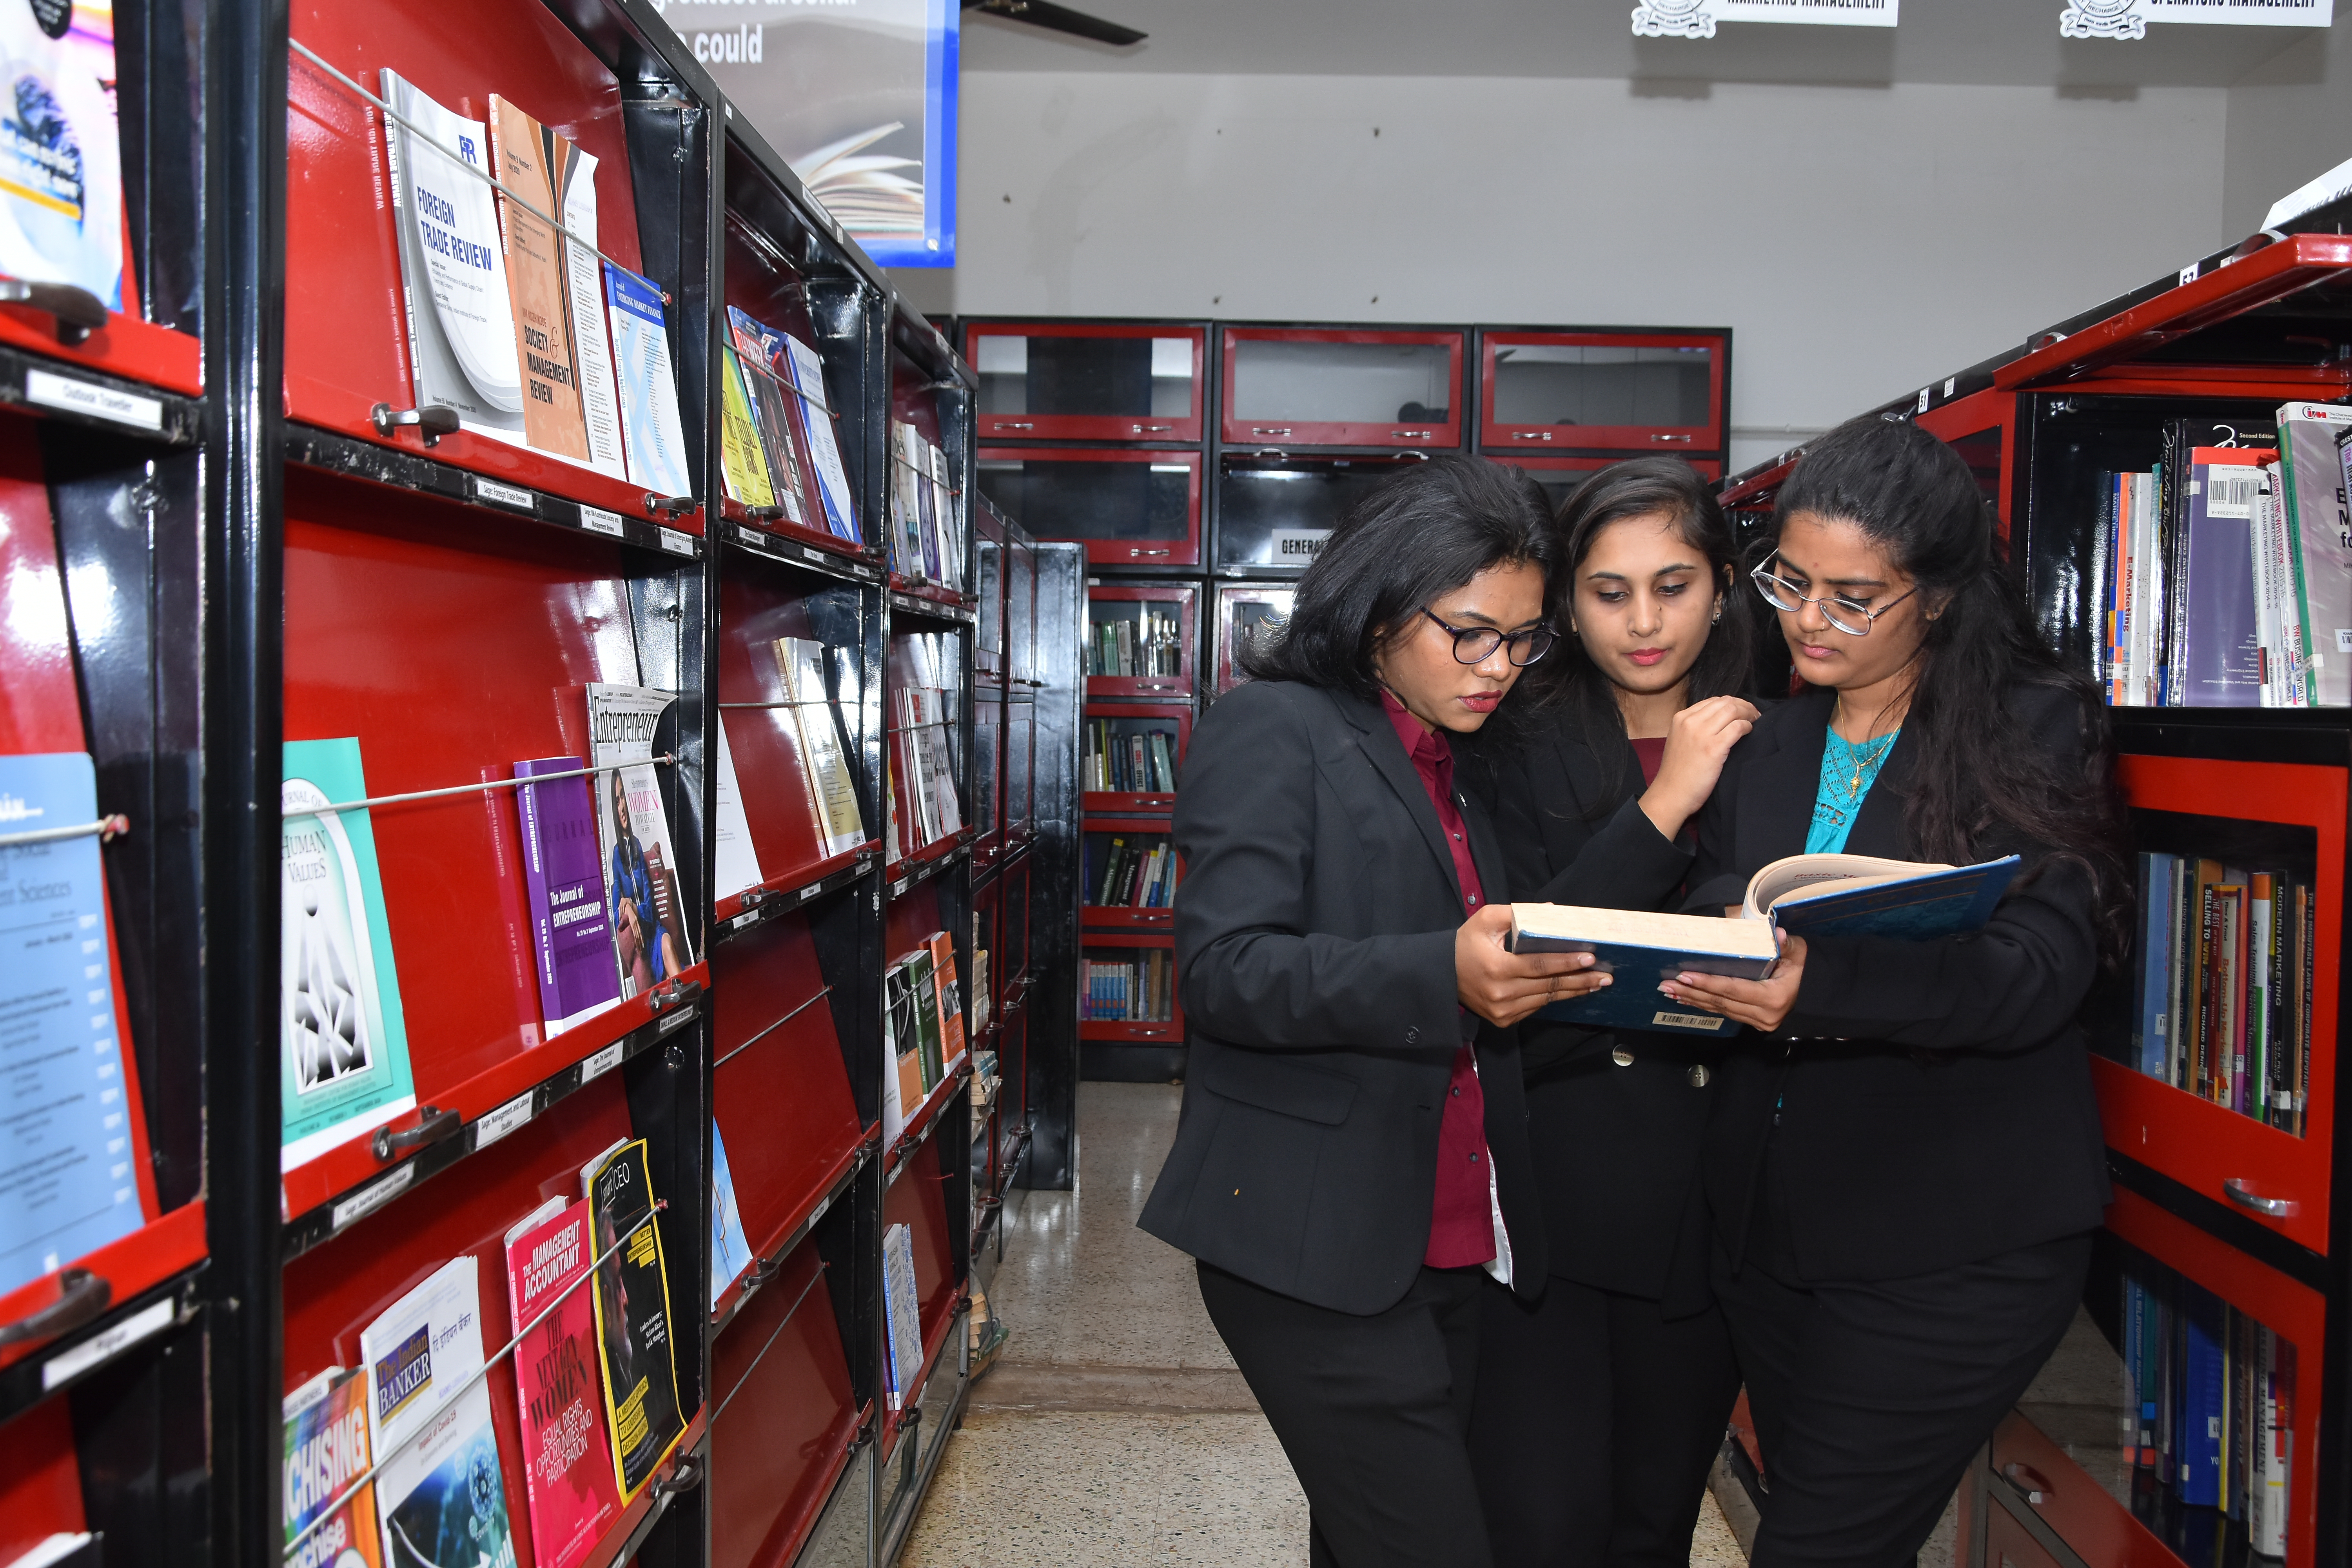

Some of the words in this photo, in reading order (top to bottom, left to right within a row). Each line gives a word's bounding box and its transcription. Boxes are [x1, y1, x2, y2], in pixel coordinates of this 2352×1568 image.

[694, 23, 762, 64] could
[387, 142, 397, 172] TRADE
[390, 173, 402, 207] REVIEW
[417, 185, 456, 228] FOREIGN
[421, 220, 450, 257] TRADE
[451, 234, 492, 271] REVIEW
[617, 290, 634, 308] EMERGING
[634, 298, 648, 314] MARKET
[648, 304, 662, 320] FINANCE
[524, 325, 549, 353] SOCIETY
[550, 326, 559, 359] &
[527, 351, 570, 386] MANAGEMENT
[530, 378, 554, 405] REVIEW
[1920, 394, 1926, 408] 51
[493, 487, 506, 501] Foreign
[506, 490, 516, 501] Trade
[516, 492, 527, 504] Review
[592, 520, 606, 530] Management
[606, 523, 614, 532] Review
[2275, 517, 2284, 566] WHITEBOOK
[2122, 556, 2133, 633] E-Marketing
[594, 695, 659, 753] Entrepreneur
[627, 789, 659, 814] WOMEN
[641, 812, 655, 824] WATCH
[529, 822, 540, 873] ENTREPRENEURSHIP
[289, 857, 326, 882] VALUES
[1122, 864, 1136, 900] Management
[550, 891, 559, 906] The
[560, 886, 577, 904] Journal
[578, 884, 584, 899] of
[2204, 889, 2212, 925] SELLING
[553, 901, 601, 927] ENTREPRENEURSHIP
[2203, 928, 2210, 939] TO
[2306, 991, 2311, 1001] OF
[481, 1116, 491, 1129] Sage:
[492, 1105, 512, 1124] Management
[519, 1096, 530, 1109] Labour
[501, 1120, 512, 1131] Studies
[613, 1162, 630, 1190] CEO
[523, 1262, 532, 1278] THE
[532, 1219, 580, 1271] MANAGEMENT
[640, 1227, 651, 1238] BETTER
[628, 1240, 652, 1260] ENTREPRENEURSHIP
[524, 1242, 580, 1303] ACCOUNTANT
[546, 1310, 563, 1350] THE
[376, 1356, 396, 1387] The
[397, 1334, 428, 1374] Indian
[377, 1352, 431, 1415] BANKER
[530, 1358, 588, 1432] WOMEN
[621, 1393, 636, 1416] MEDITATIVE
[636, 1379, 647, 1399] APPROACH
[542, 1422, 563, 1451] EQUAL
[563, 1397, 583, 1426] RIGHTS
[536, 1419, 579, 1478] OPPORTUNITIES
[580, 1408, 592, 1434] AND
[546, 1433, 588, 1488] PARTICIPATION
